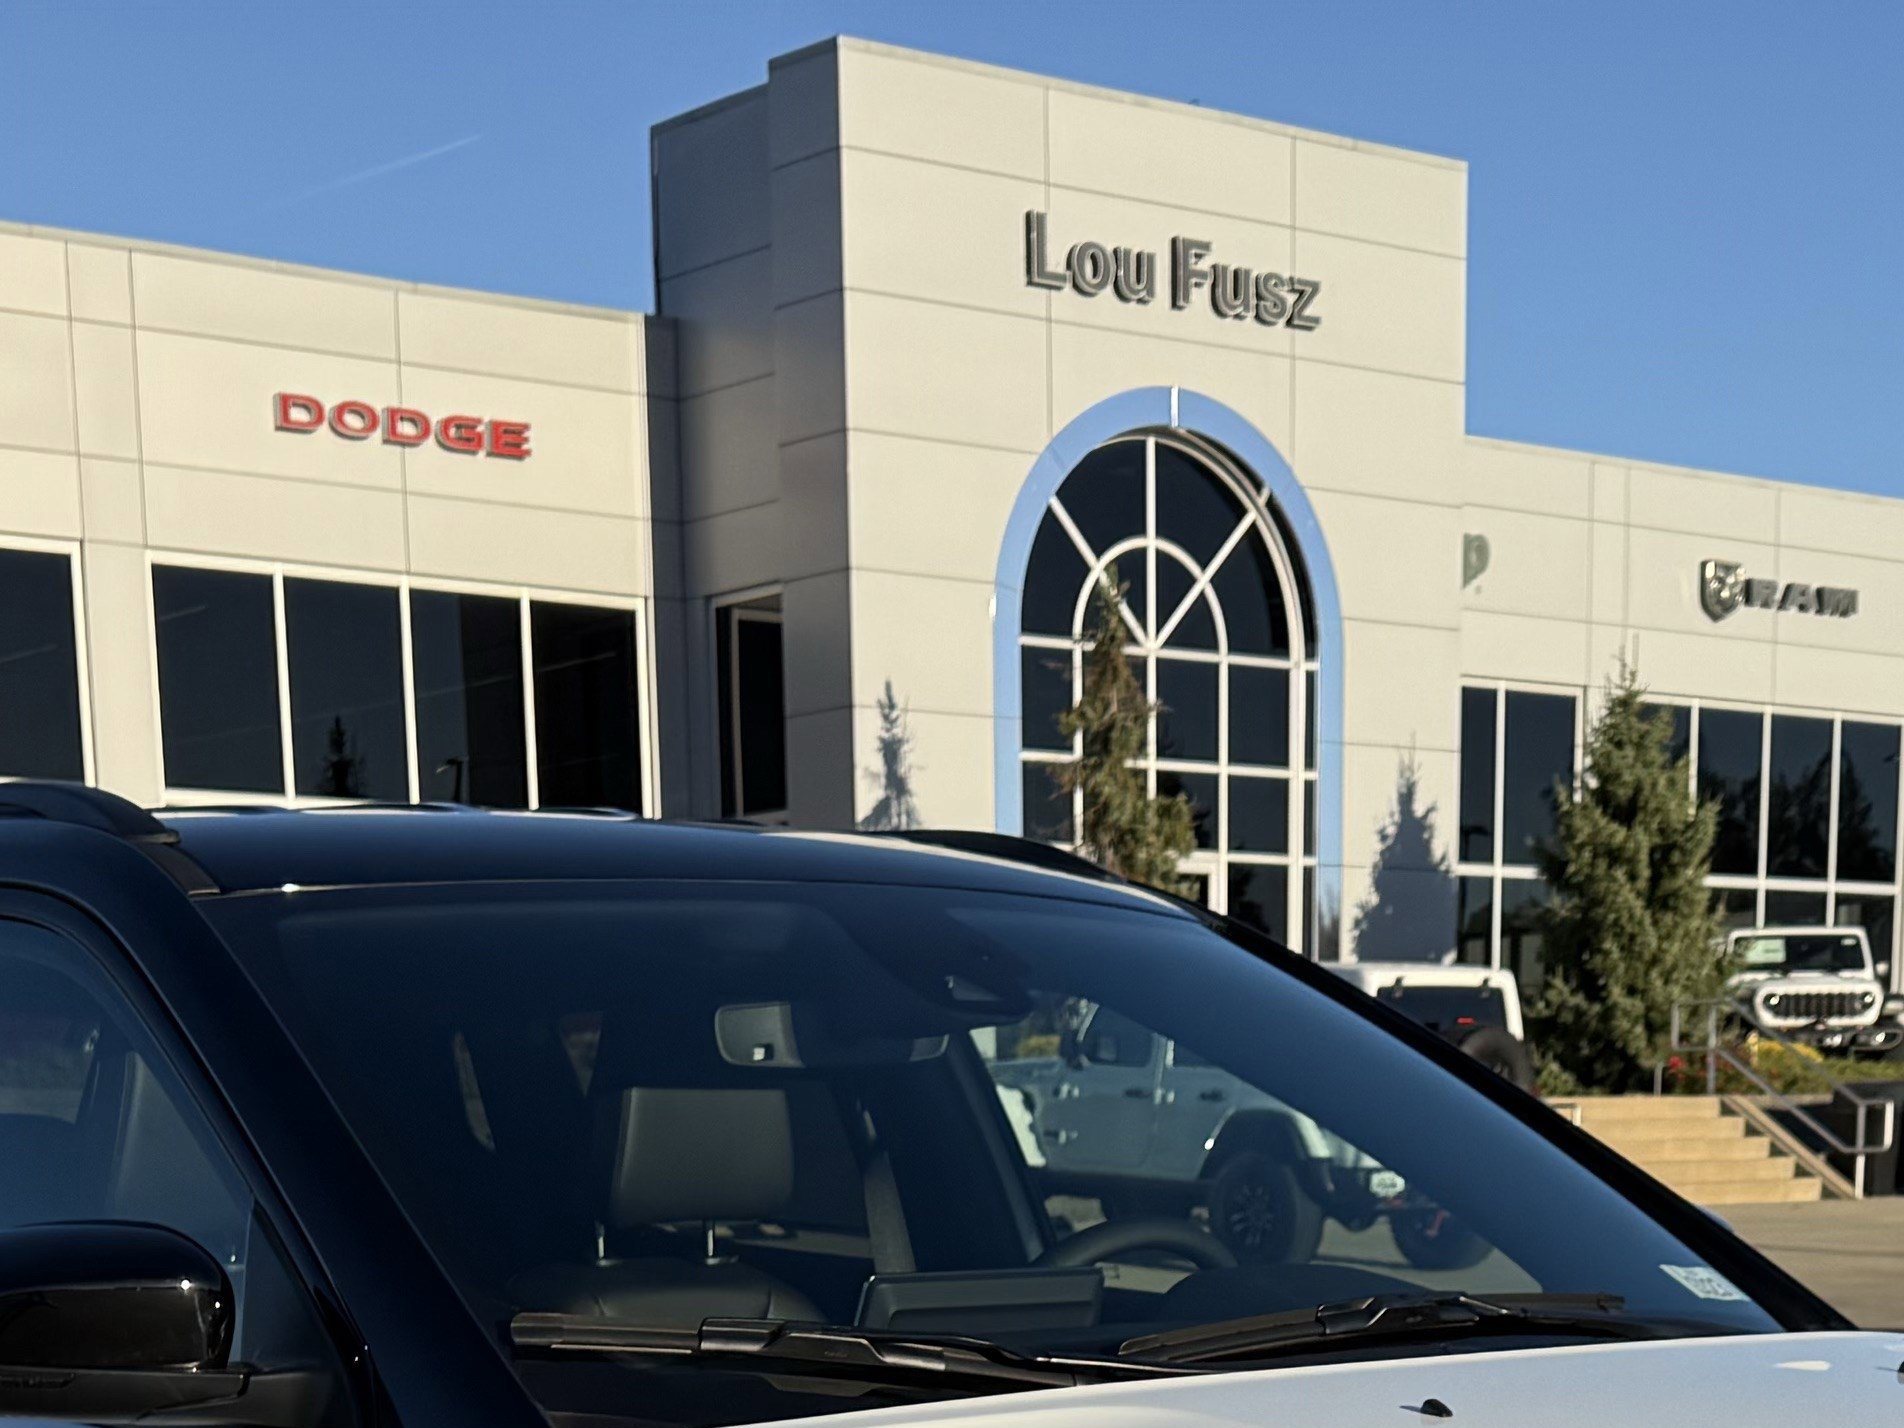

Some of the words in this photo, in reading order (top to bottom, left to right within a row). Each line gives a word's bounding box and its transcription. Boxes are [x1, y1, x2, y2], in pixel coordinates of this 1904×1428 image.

[1025, 209, 1156, 305] Lou
[1170, 235, 1322, 332] Fusz
[273, 391, 532, 460] DODGE
[1744, 577, 1859, 618] RAM
